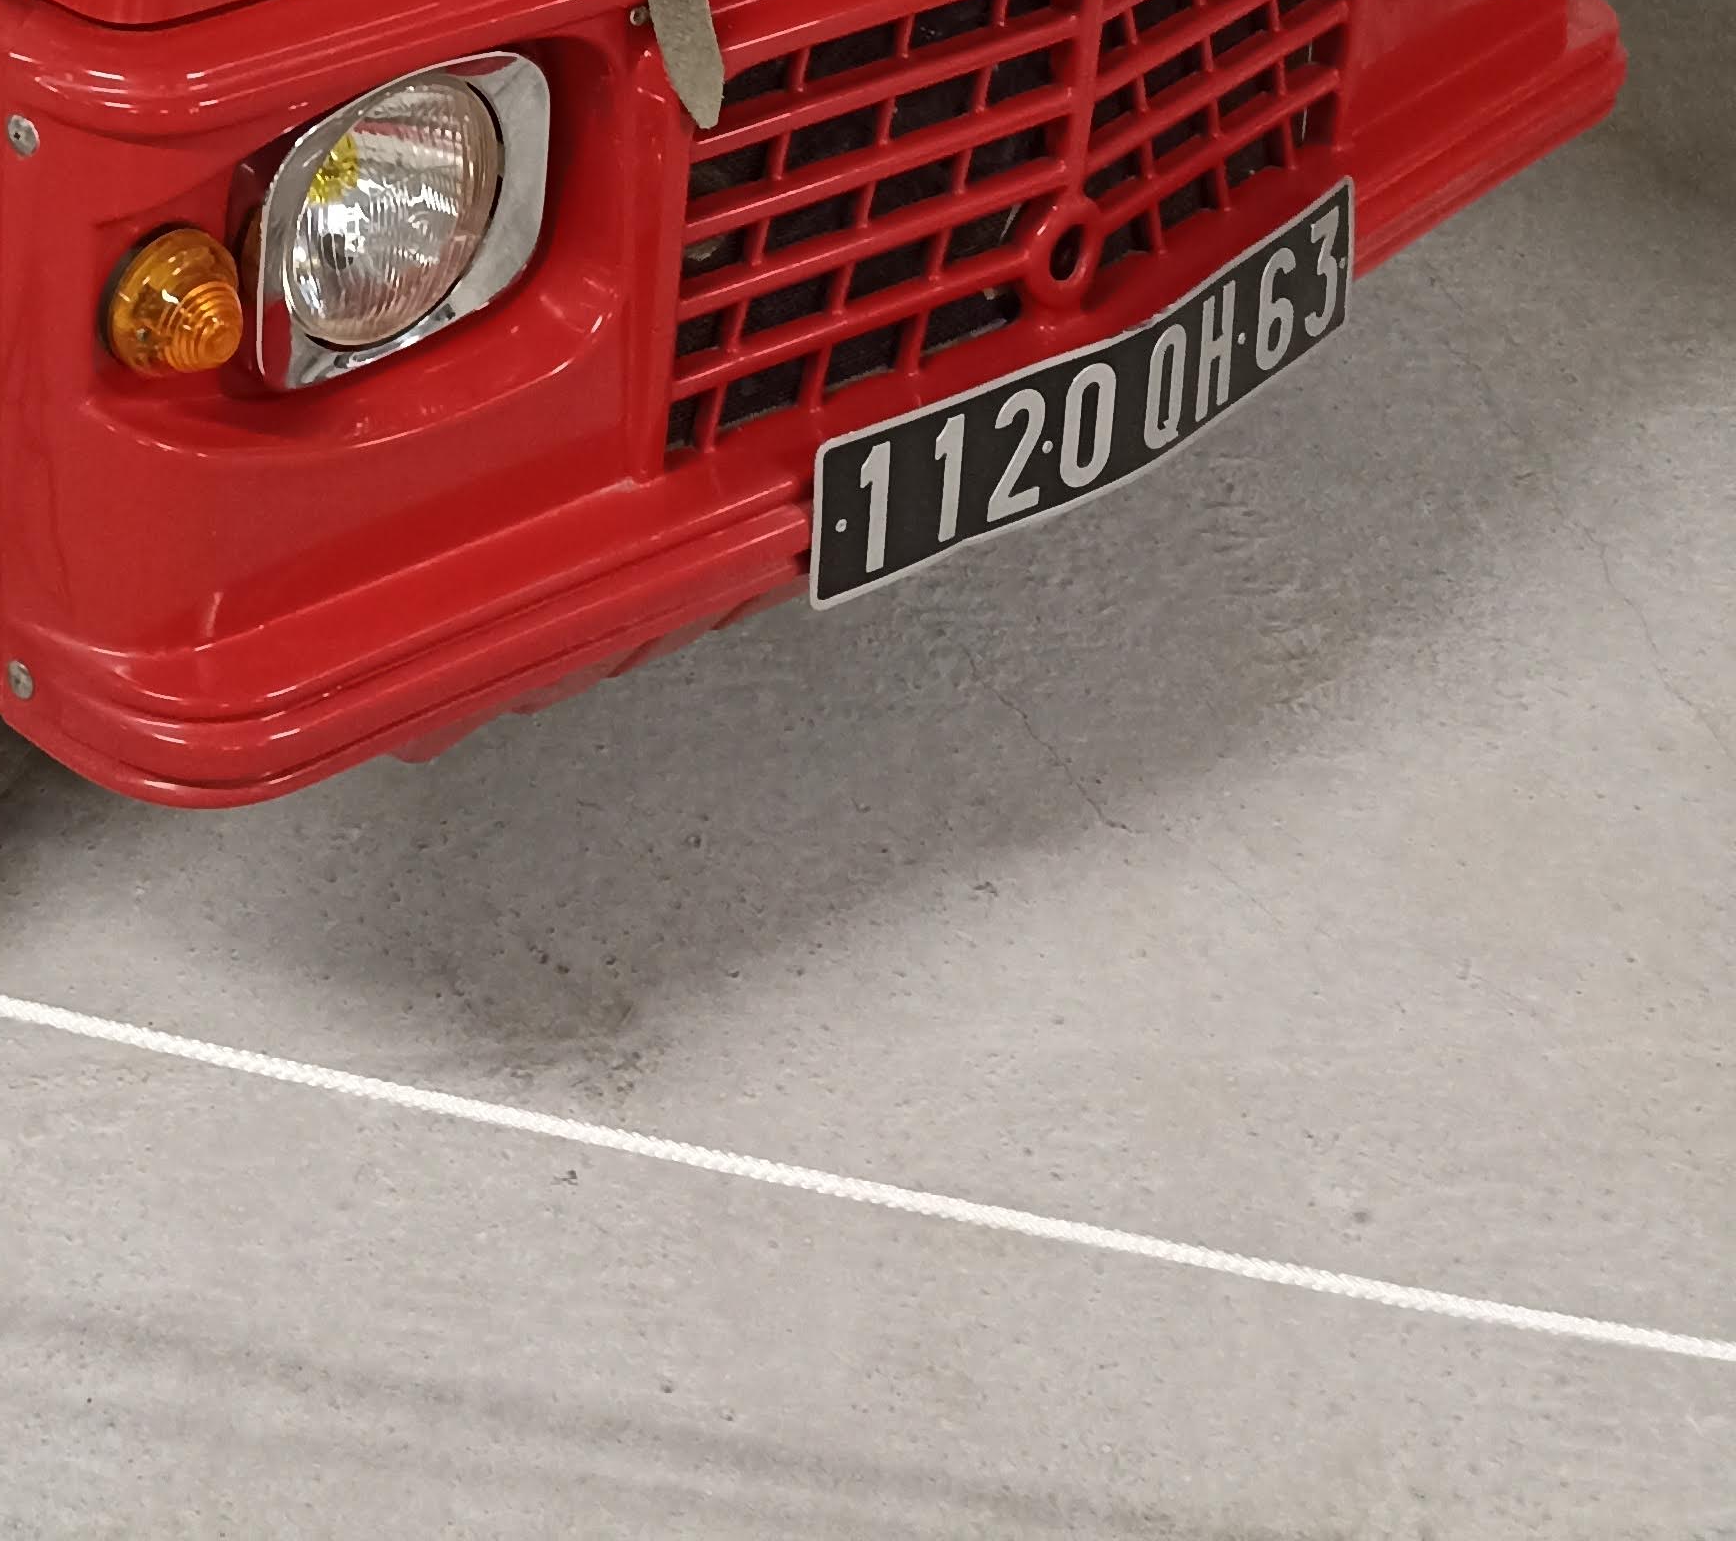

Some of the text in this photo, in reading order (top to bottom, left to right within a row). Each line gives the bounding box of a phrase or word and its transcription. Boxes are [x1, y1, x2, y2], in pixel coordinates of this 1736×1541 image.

[860, 206, 1340, 574] 1120 QH 63
